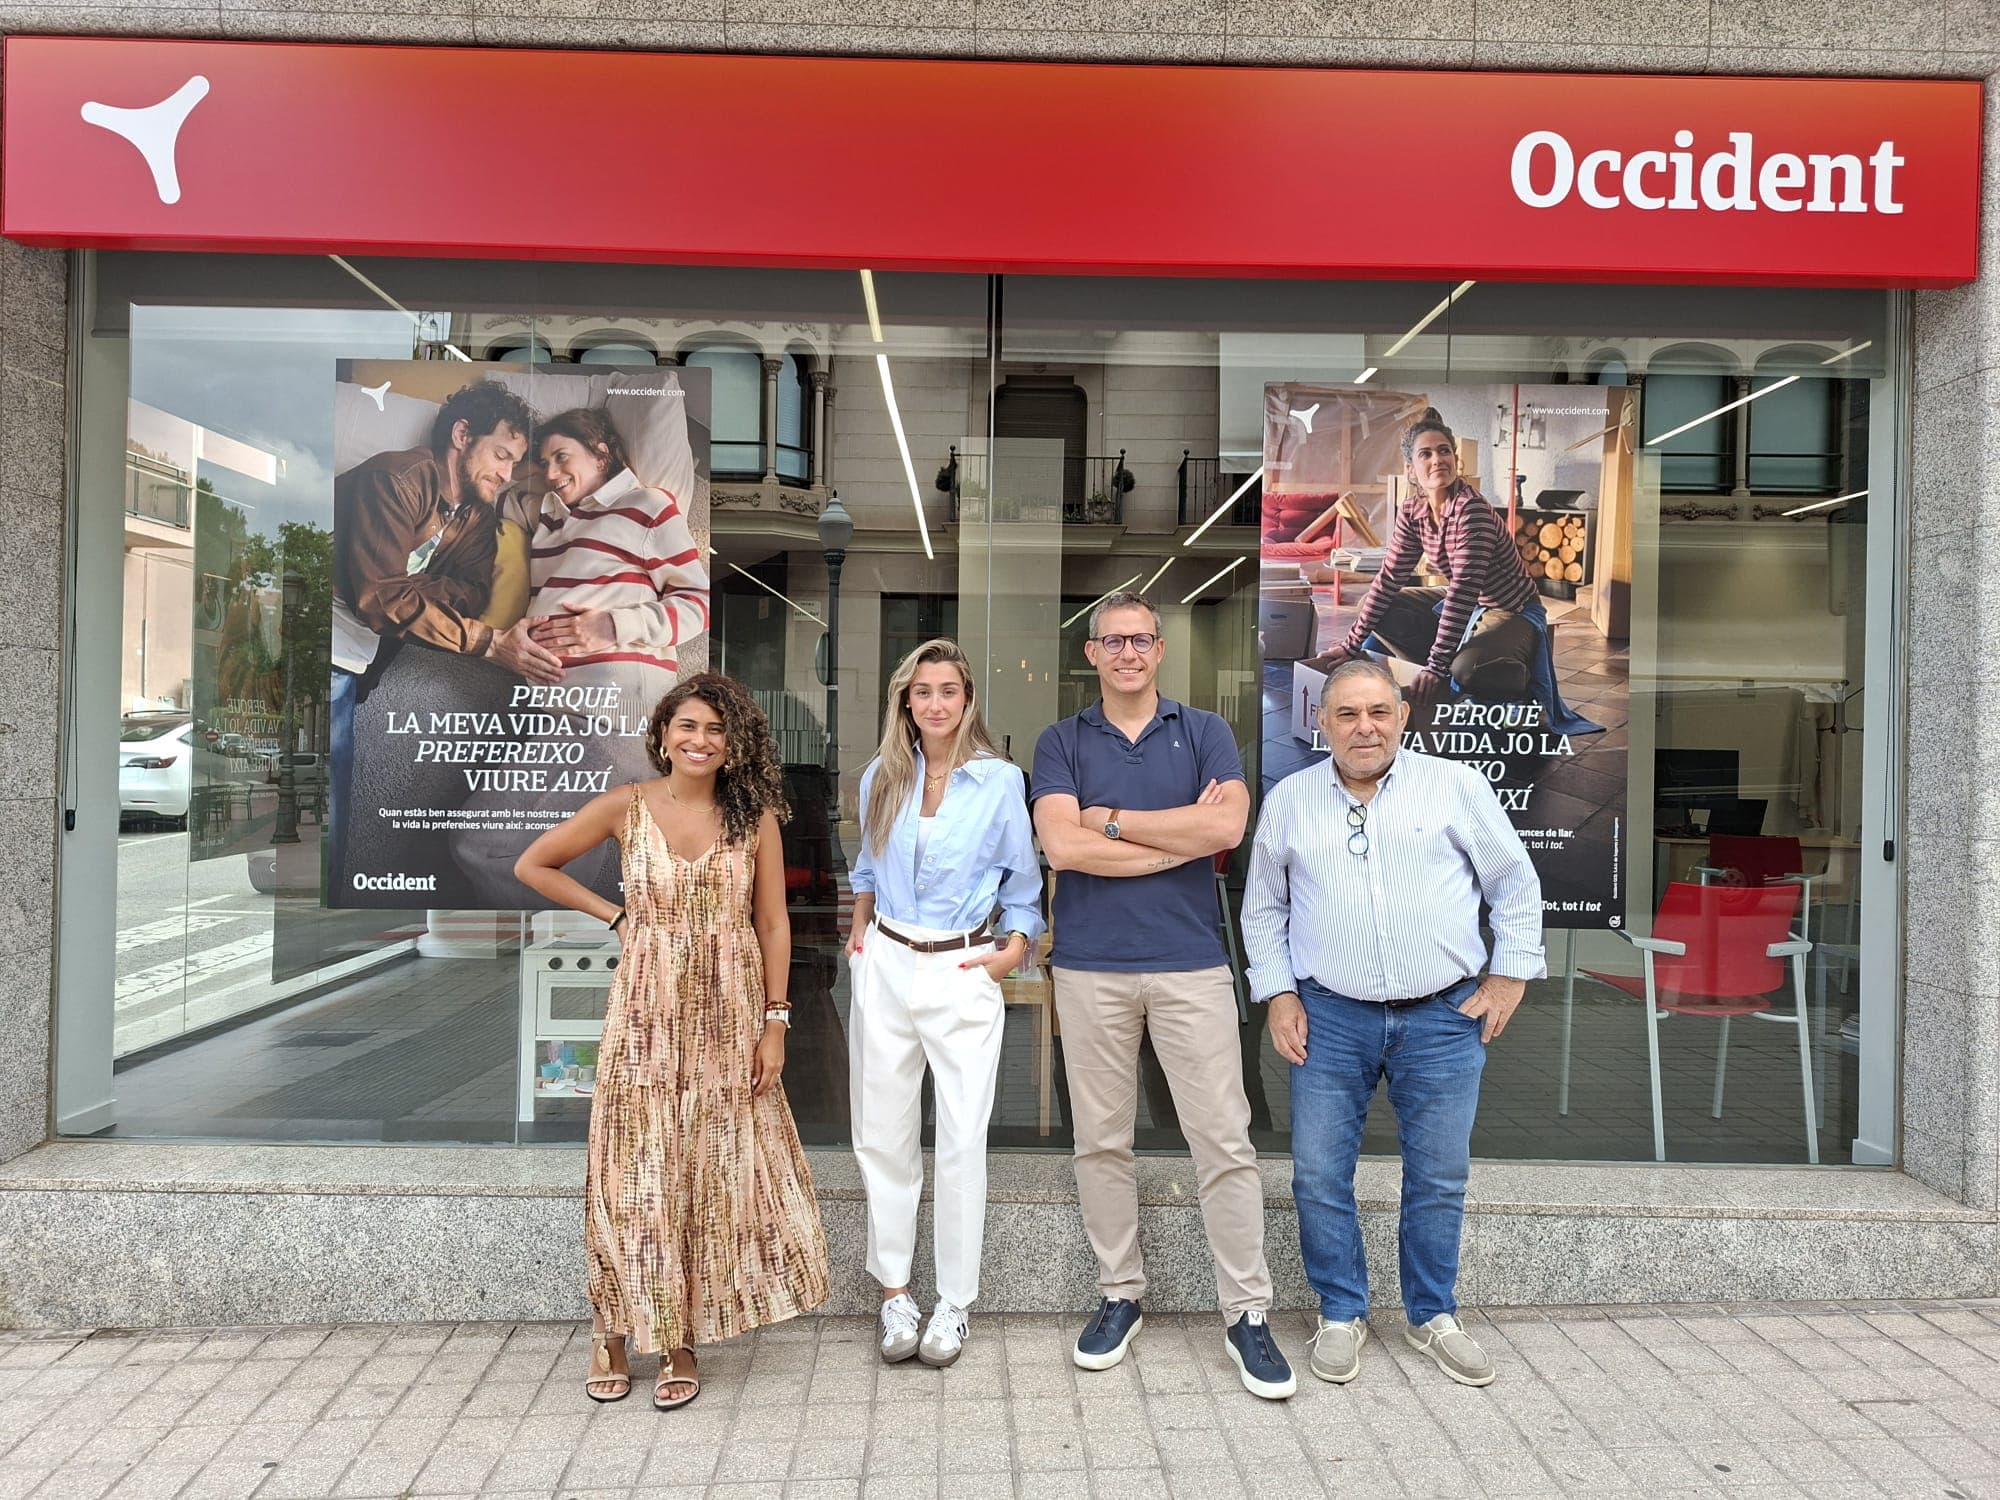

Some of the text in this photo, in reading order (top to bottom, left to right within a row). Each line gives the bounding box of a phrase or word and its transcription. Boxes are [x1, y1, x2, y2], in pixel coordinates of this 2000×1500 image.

[1511, 130, 1904, 214] Occident
[607, 387, 686, 397] www.occident.com
[1532, 406, 1610, 416] www.occident.com
[509, 682, 621, 711] PERQUÈ
[1431, 699, 1543, 730] PERQUÈ
[386, 712, 648, 737] LA MEVA VIDA JO LA
[414, 740, 584, 764] PREFEREIXO
[1311, 729, 1331, 751] L
[1430, 732, 1496, 754] VIDA
[1500, 733, 1534, 755] JO
[1539, 733, 1575, 756] LA
[463, 765, 613, 792] VIURE AIXÍ
[379, 807, 402, 818] Quan
[404, 807, 427, 817] estàs
[429, 807, 445, 817] ben
[447, 808, 489, 820] assegurat
[491, 808, 511, 818] amb
[513, 808, 525, 818] les
[527, 809, 559, 819] nostres
[392, 819, 400, 829] la
[402, 820, 421, 829] vida
[422, 819, 430, 829] la
[432, 819, 480, 831] prefereixes
[482, 820, 504, 830] viure
[1545, 828, 1557, 838] de
[1558, 828, 1575, 839] llar,
[1531, 840, 1544, 849] tot
[1550, 840, 1565, 850] tot.
[353, 872, 437, 891] Occident
[1541, 900, 1560, 912] Tot,
[1562, 901, 1578, 912] tot
[1586, 901, 1602, 912] tot
